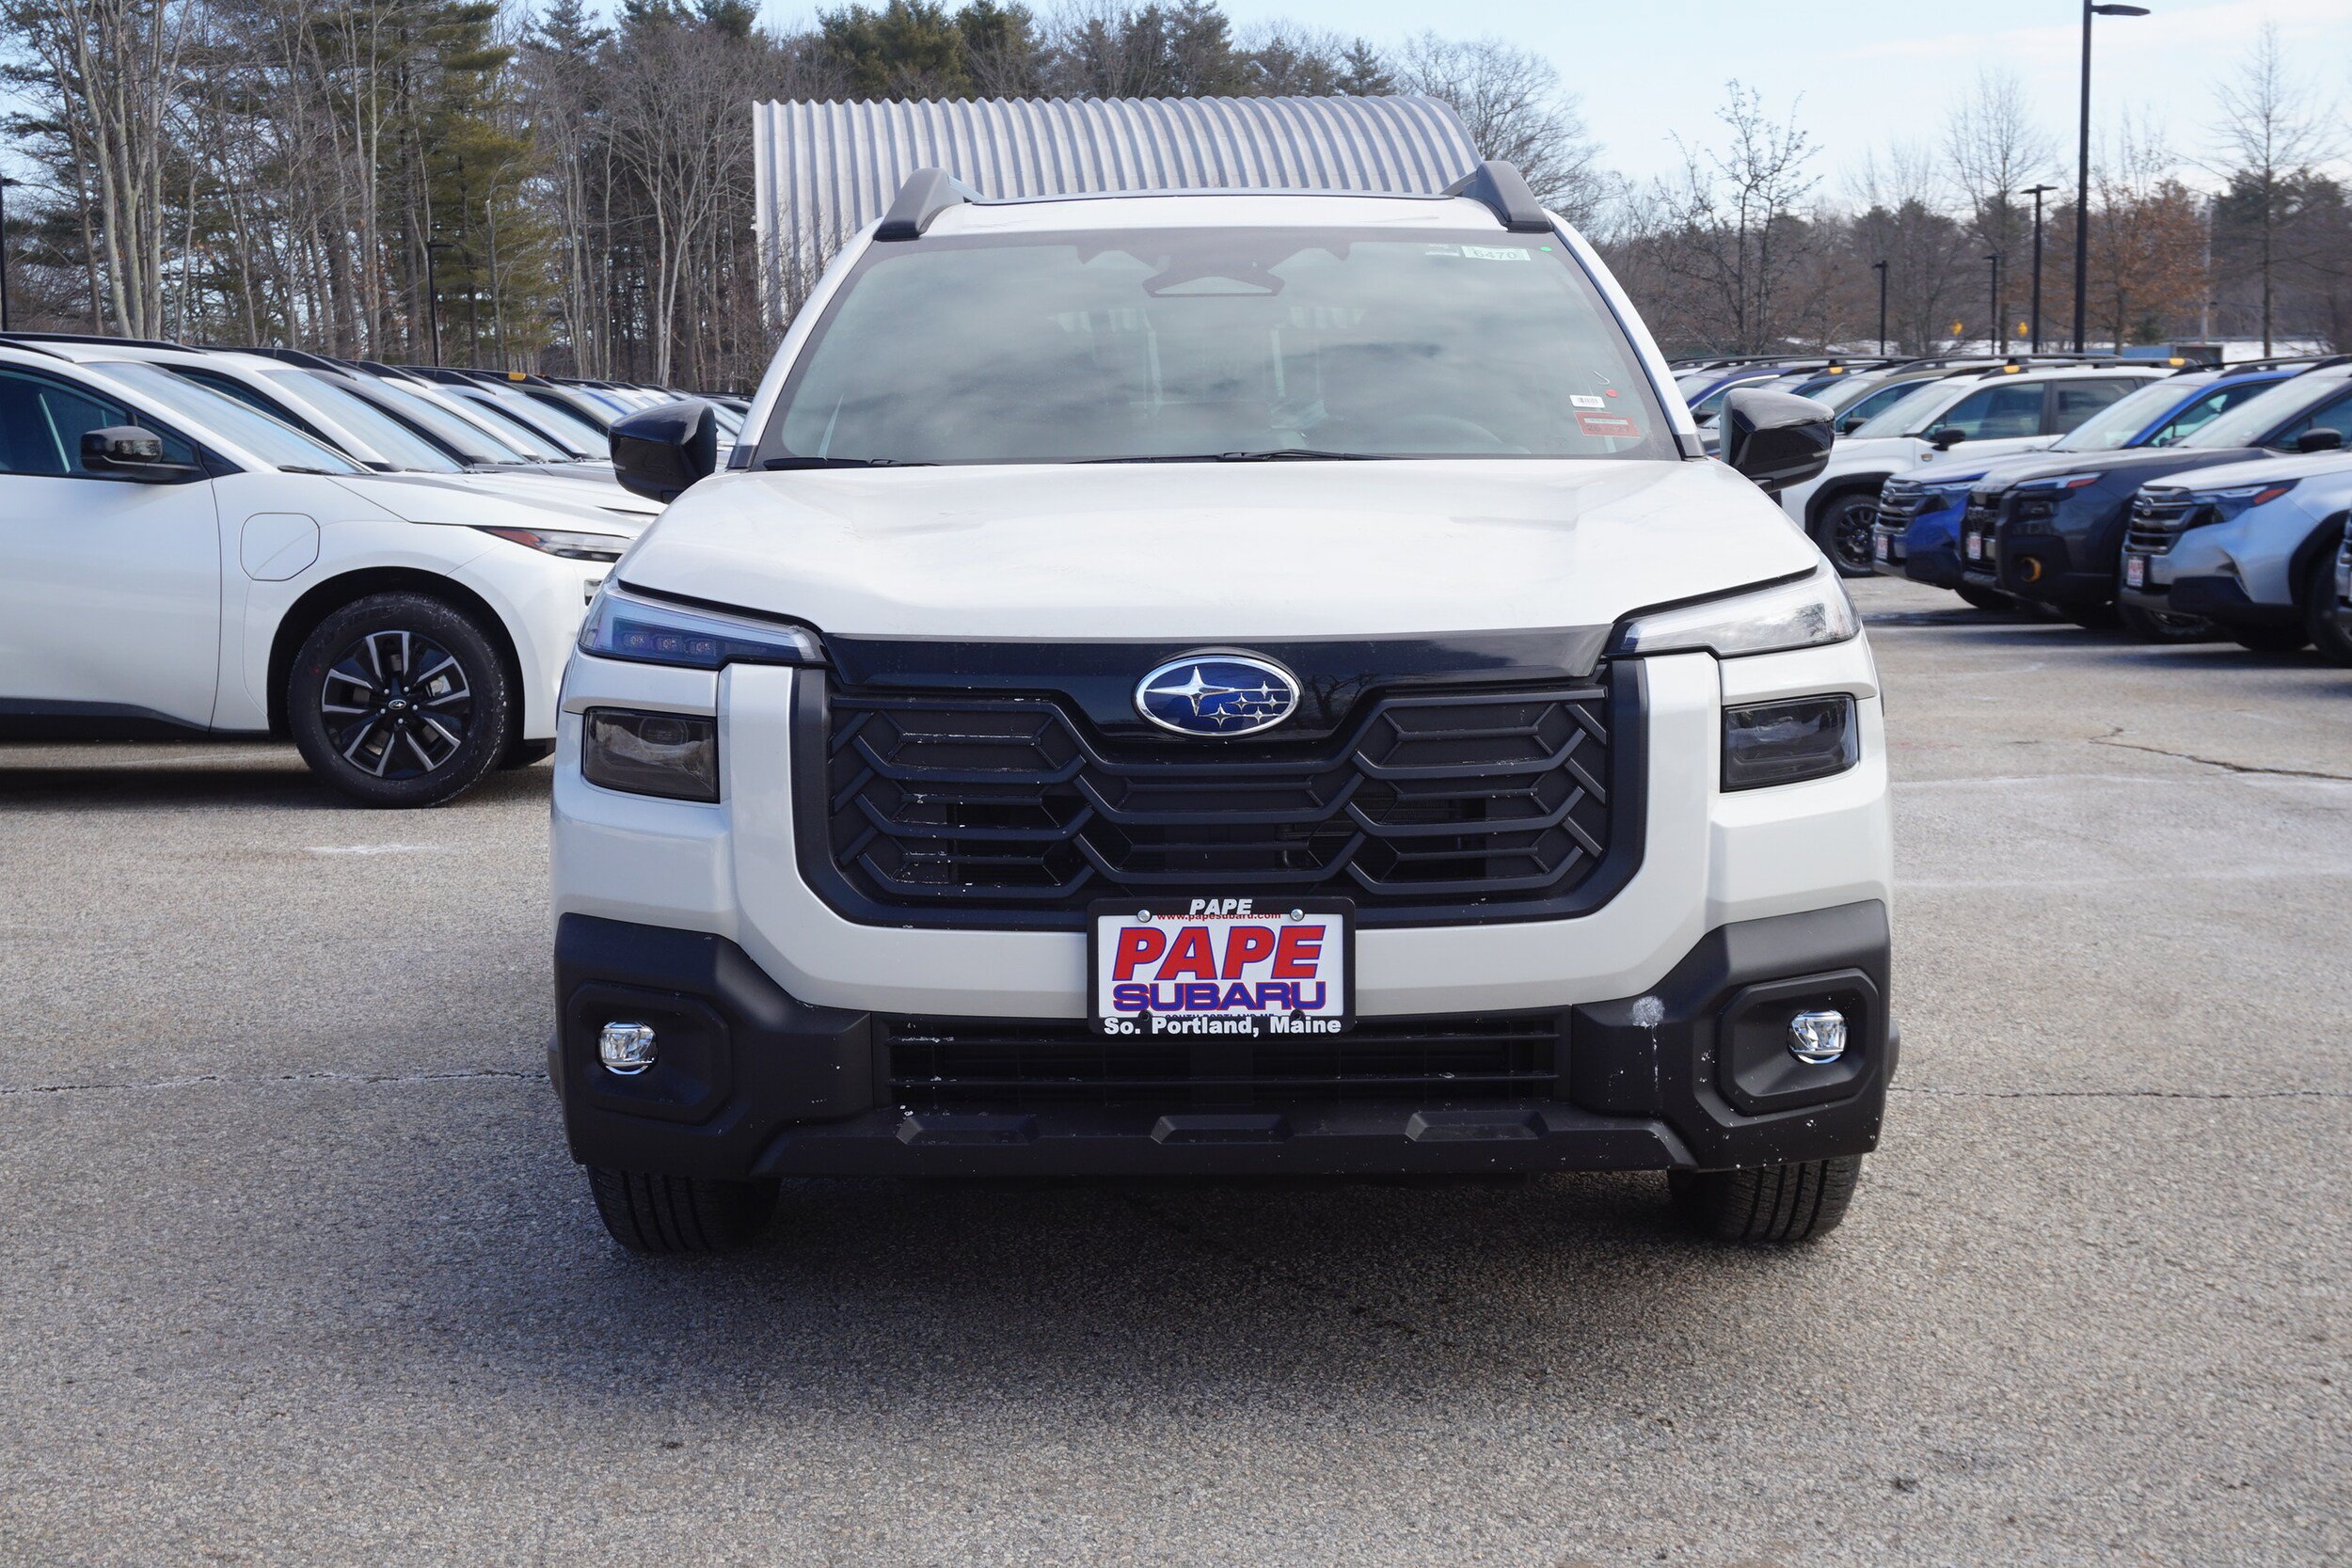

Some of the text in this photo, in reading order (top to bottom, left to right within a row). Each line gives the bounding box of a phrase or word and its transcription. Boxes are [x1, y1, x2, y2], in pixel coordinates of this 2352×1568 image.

[1473, 249, 1517, 260] 6470
[1189, 898, 1253, 915] PAPE
[1112, 925, 1327, 981] PAPE
[1113, 981, 1327, 1012] SUBARU
[1104, 1017, 1342, 1037] So. Portland, Maine
